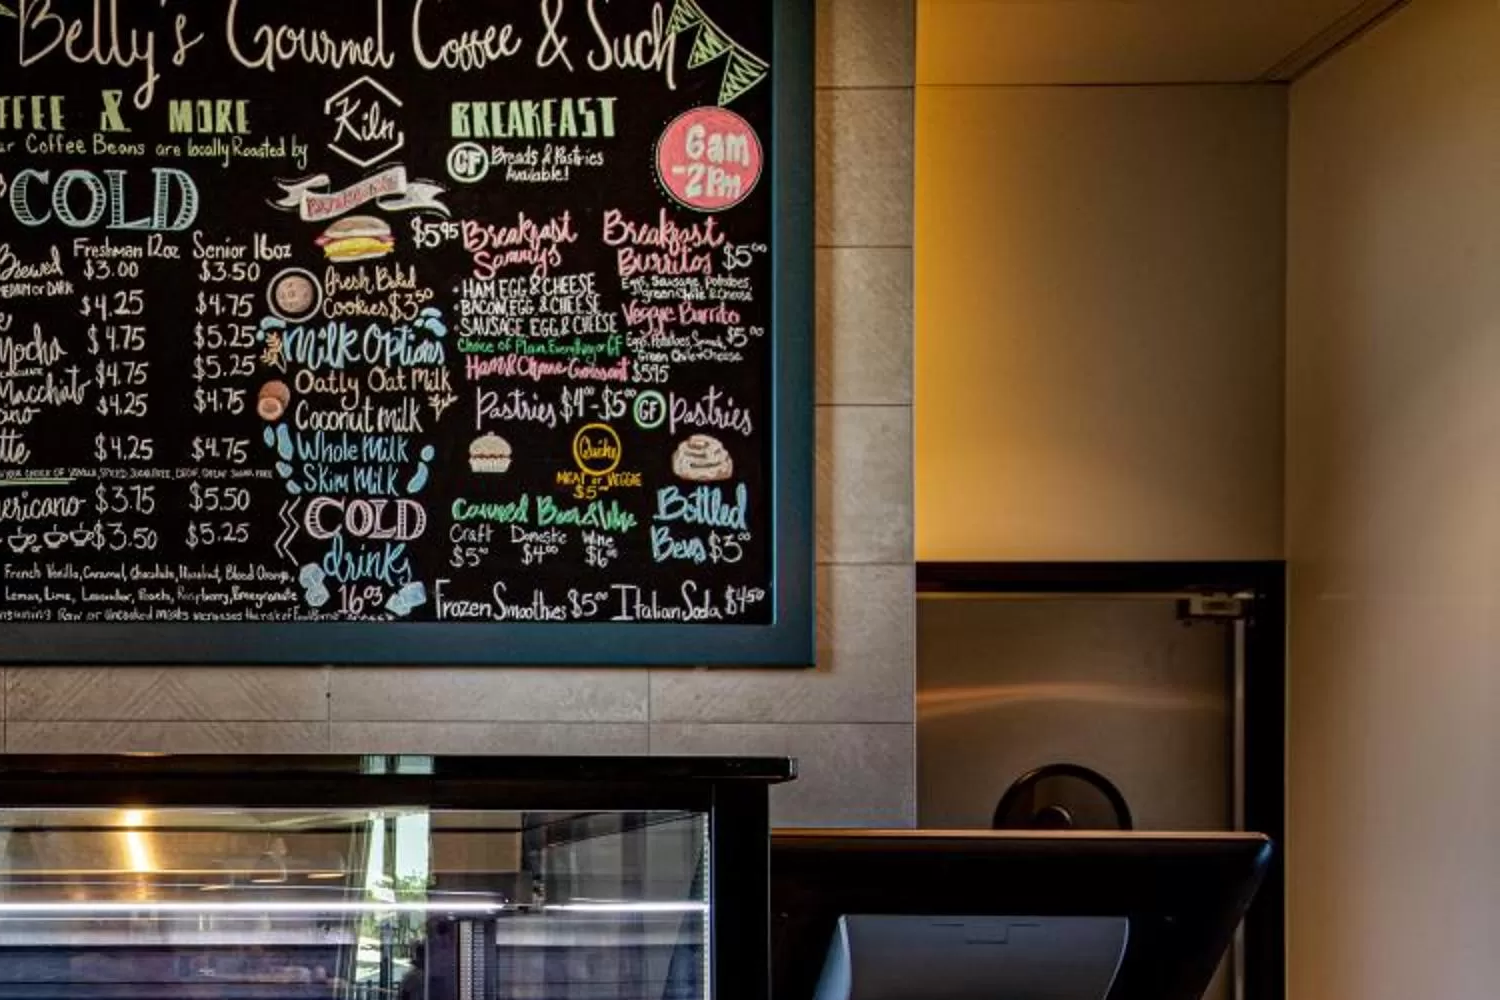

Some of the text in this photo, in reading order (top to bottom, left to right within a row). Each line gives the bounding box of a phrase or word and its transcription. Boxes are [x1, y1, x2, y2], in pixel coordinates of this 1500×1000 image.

[411, 0, 522, 72] Coffee
[537, 0, 575, 72] &
[586, 0, 677, 91] Such
[168, 99, 251, 135] MORE
[334, 96, 396, 142] Kiln
[451, 97, 618, 139] BREAKFAST
[25, 131, 87, 155] Coffee
[93, 132, 146, 156] Beans
[155, 144, 181, 157] are
[187, 136, 230, 168] locally
[231, 135, 287, 158] Roasted
[291, 133, 309, 171] by
[490, 145, 539, 166] Breads
[555, 145, 605, 166] Pastries
[686, 123, 750, 167] 6am
[9, 166, 199, 231] COLD
[73, 229, 293, 260] Freshman 12oz Senior 16oz
[461, 209, 579, 253] Breakfast
[603, 207, 725, 257] Breakfast
[84, 259, 139, 281] $3.00
[198, 259, 260, 282] $3.50
[617, 245, 712, 277] Burritos
[47, 280, 74, 297] DARK
[499, 276, 527, 299] EGG
[529, 275, 541, 295] &
[542, 272, 596, 297] CHEESE
[79, 289, 145, 321] $4.25
[195, 290, 256, 317] $4.75
[322, 295, 389, 320] Cookies
[509, 299, 535, 316] EGG
[550, 293, 601, 315] CHEESE
[679, 301, 740, 325] Burrito
[87, 323, 146, 355] $4.75
[194, 321, 257, 350] $5.25
[530, 317, 560, 337] EGG
[572, 311, 618, 334] CHEESE
[283, 320, 445, 370] Milk Options
[498, 337, 511, 351] of
[95, 359, 149, 389] $4.75
[192, 354, 256, 382] $5.25
[96, 391, 149, 417] $4.25
[193, 385, 246, 414] $4.75
[295, 366, 453, 411] Oatly Oat Milk
[295, 395, 375, 432] Coconut
[477, 386, 557, 430] Pastries
[639, 385, 753, 437] GF Pastries
[94, 431, 155, 462] $4.25
[191, 435, 250, 464] $4.75
[296, 430, 409, 463] Whole Milk
[303, 463, 349, 493] Skim
[352, 465, 400, 496] Milk
[95, 481, 155, 515] $3.75
[189, 480, 251, 512] $5.50
[652, 483, 747, 531] Bottled
[304, 496, 427, 540] COLD
[91, 519, 158, 551] $3.50
[186, 520, 249, 550] $5.25
[450, 523, 614, 548] Craft Domestic Wine
[4, 561, 41, 579] French
[225, 563, 254, 581] Blood
[435, 579, 491, 620] Frozen
[493, 580, 567, 621] Smoothies
[610, 584, 680, 621] Italian
[681, 580, 723, 621] Soda
